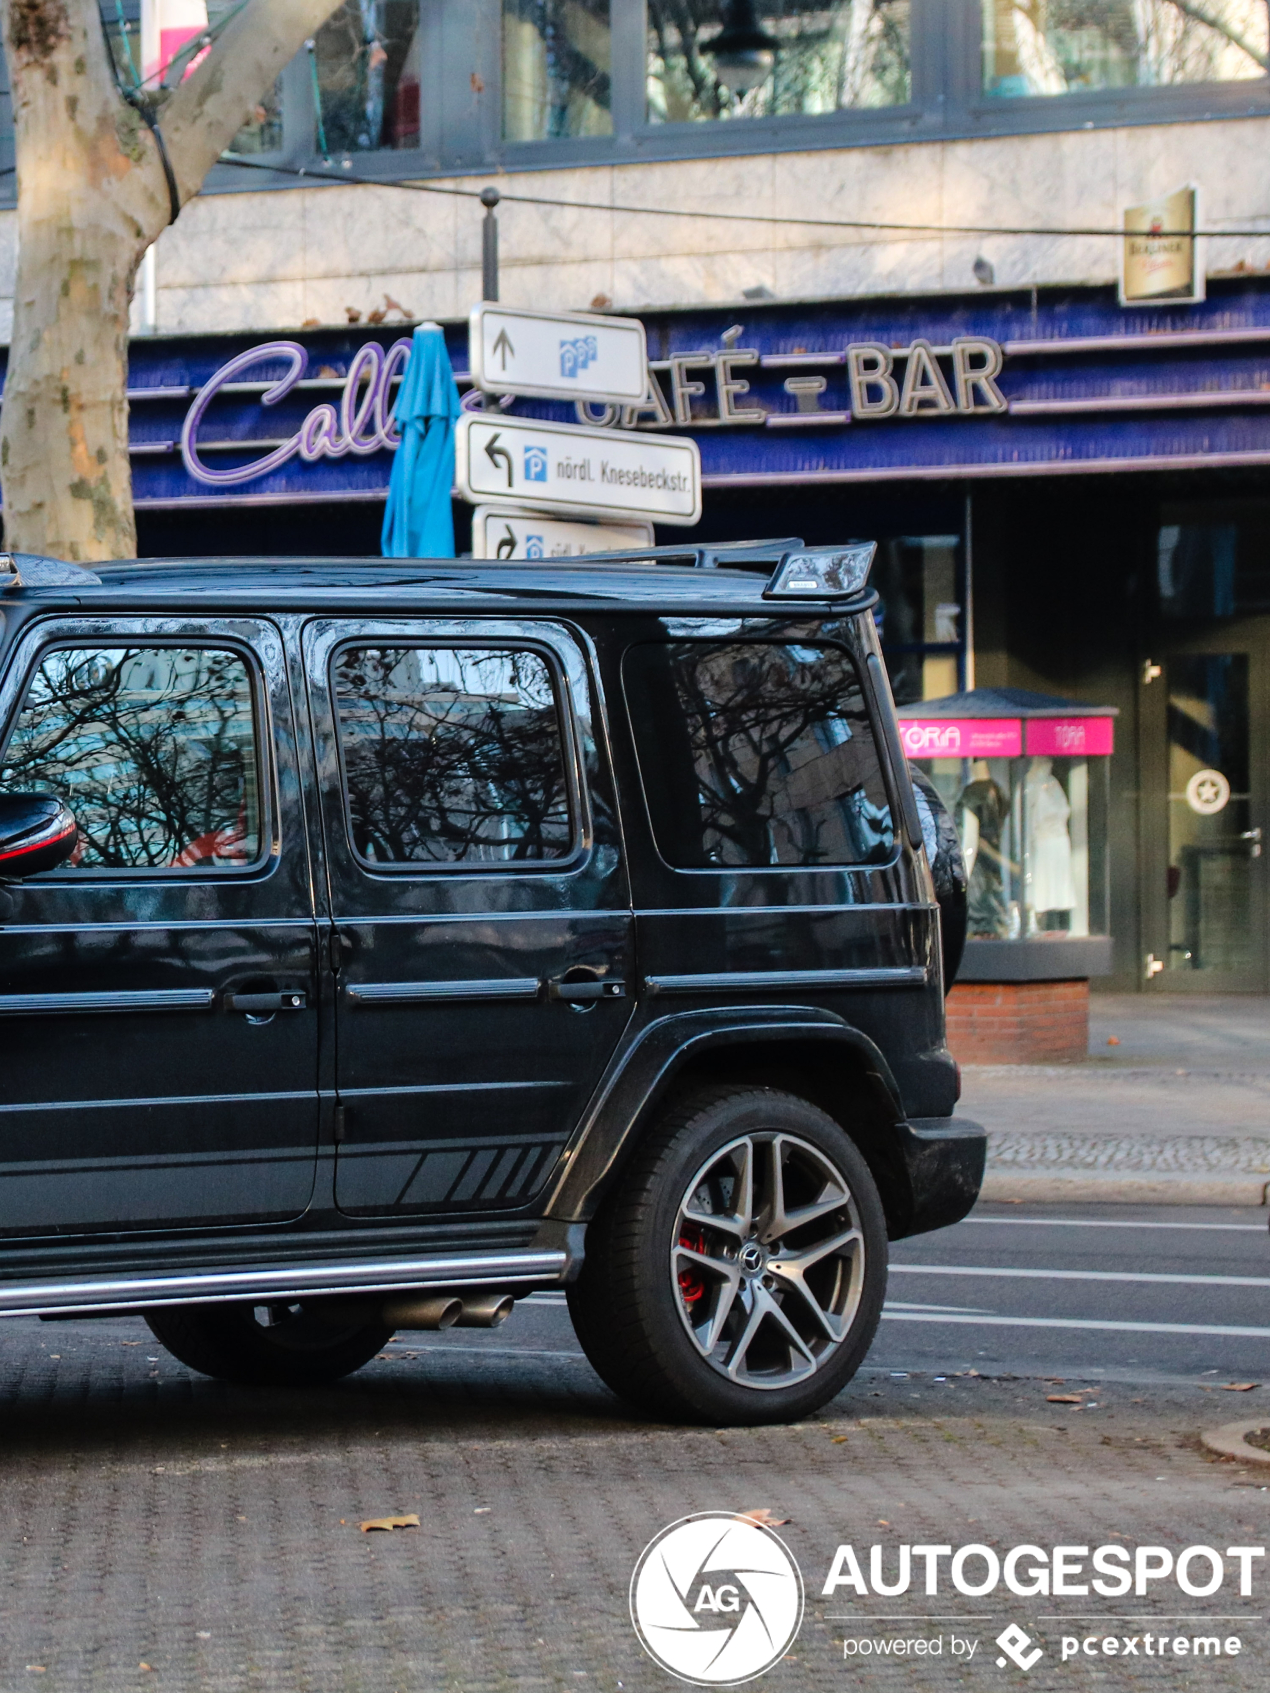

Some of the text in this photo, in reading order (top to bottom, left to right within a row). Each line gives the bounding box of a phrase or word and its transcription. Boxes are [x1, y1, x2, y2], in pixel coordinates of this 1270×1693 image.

[576, 324, 767, 428] AFÉ
[846, 336, 1008, 419] BAR
[557, 457, 595, 483] nördl.
[601, 460, 691, 493] Knesebeckstr.
